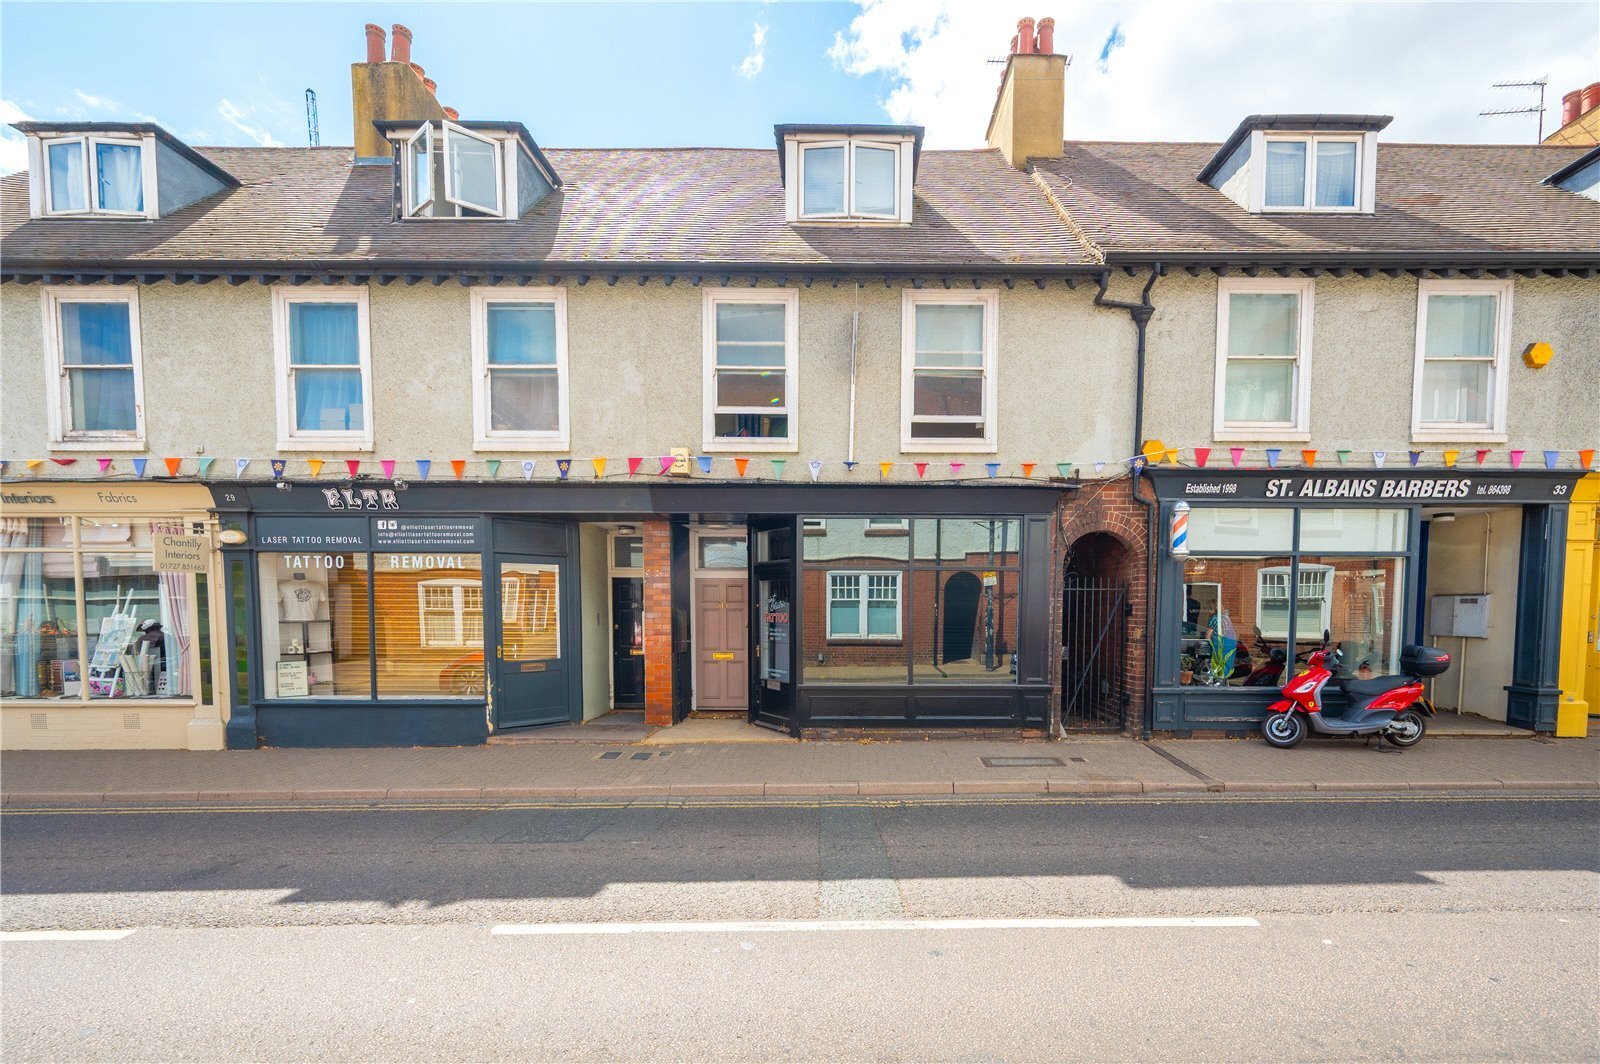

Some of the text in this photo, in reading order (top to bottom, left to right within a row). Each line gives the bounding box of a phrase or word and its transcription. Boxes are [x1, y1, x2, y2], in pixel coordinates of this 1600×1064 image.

[1185, 483, 1222, 494] Established
[1265, 479, 1472, 498] ST. ALBANS BARBERS
[1552, 485, 1568, 495] 33
[0, 491, 56, 504] Interiors
[97, 491, 138, 503] Fabrics
[321, 488, 400, 510] ELTR
[163, 536, 202, 550] Chantilly
[261, 536, 363, 544] LASER TATTOO REMOVAL
[165, 549, 200, 560] Interiors
[160, 562, 205, 571] 01727 851663
[284, 555, 345, 569] TATTOO
[390, 555, 466, 569] REMOVAL
